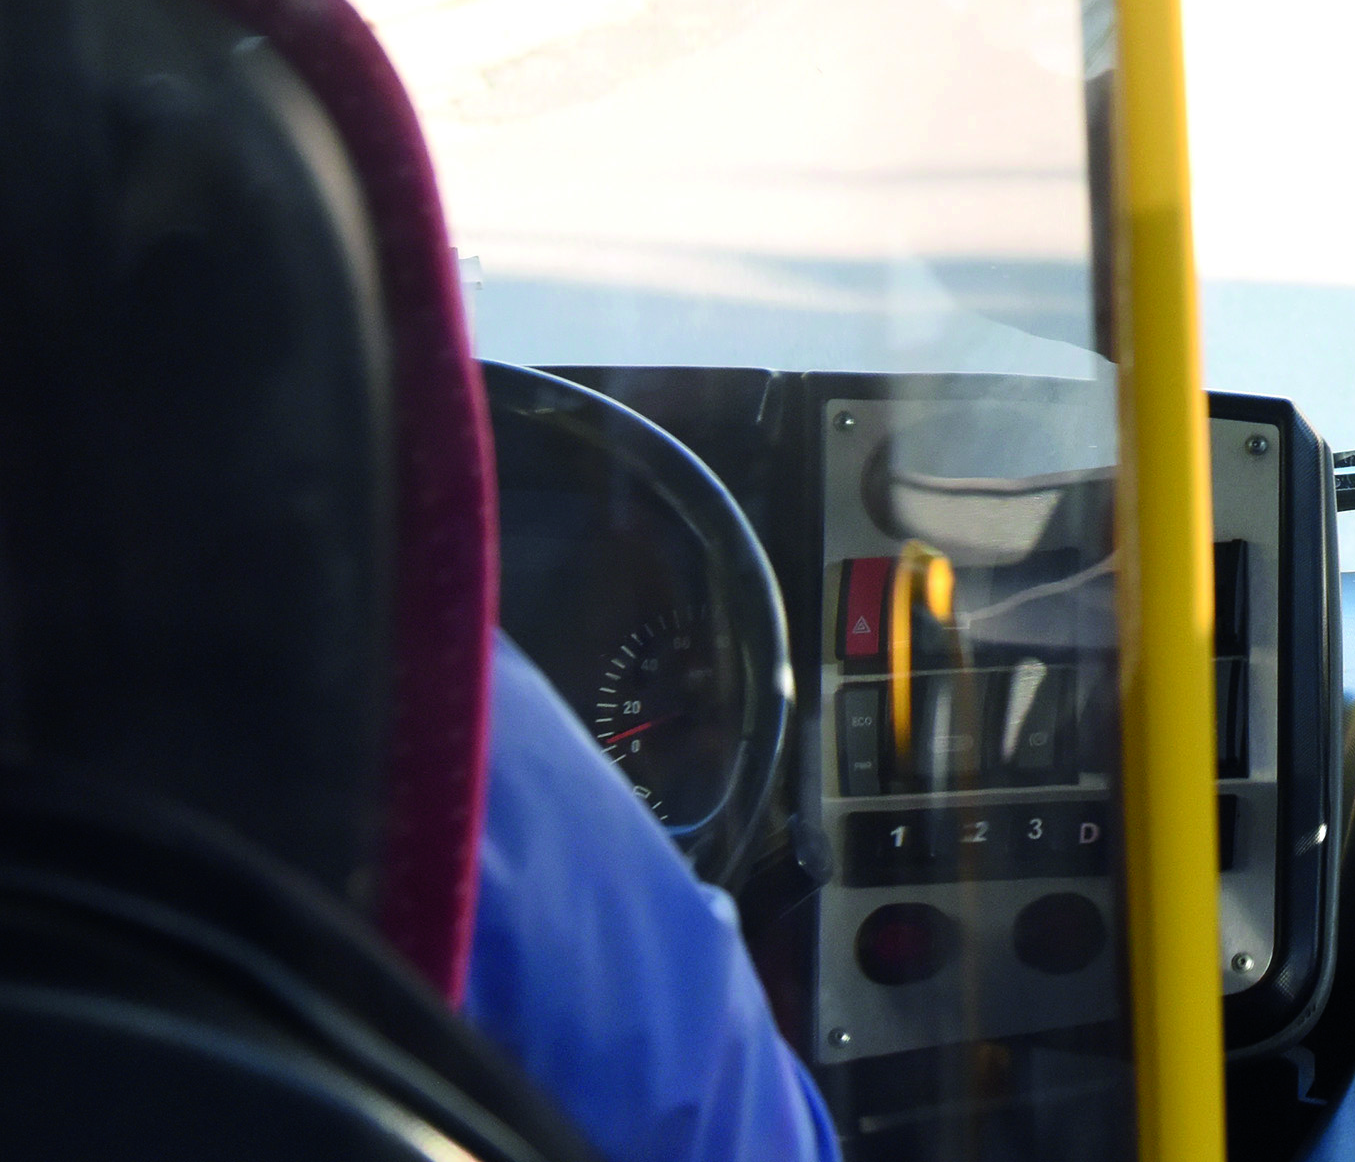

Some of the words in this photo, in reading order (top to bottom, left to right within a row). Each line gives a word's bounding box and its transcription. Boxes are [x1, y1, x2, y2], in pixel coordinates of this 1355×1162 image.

[641, 659, 659, 671] 40
[623, 701, 642, 715] 20
[631, 740, 641, 753] 0
[890, 825, 906, 847] 1
[973, 821, 990, 842] 2
[1028, 818, 1043, 839] 3
[1079, 823, 1098, 844] D
